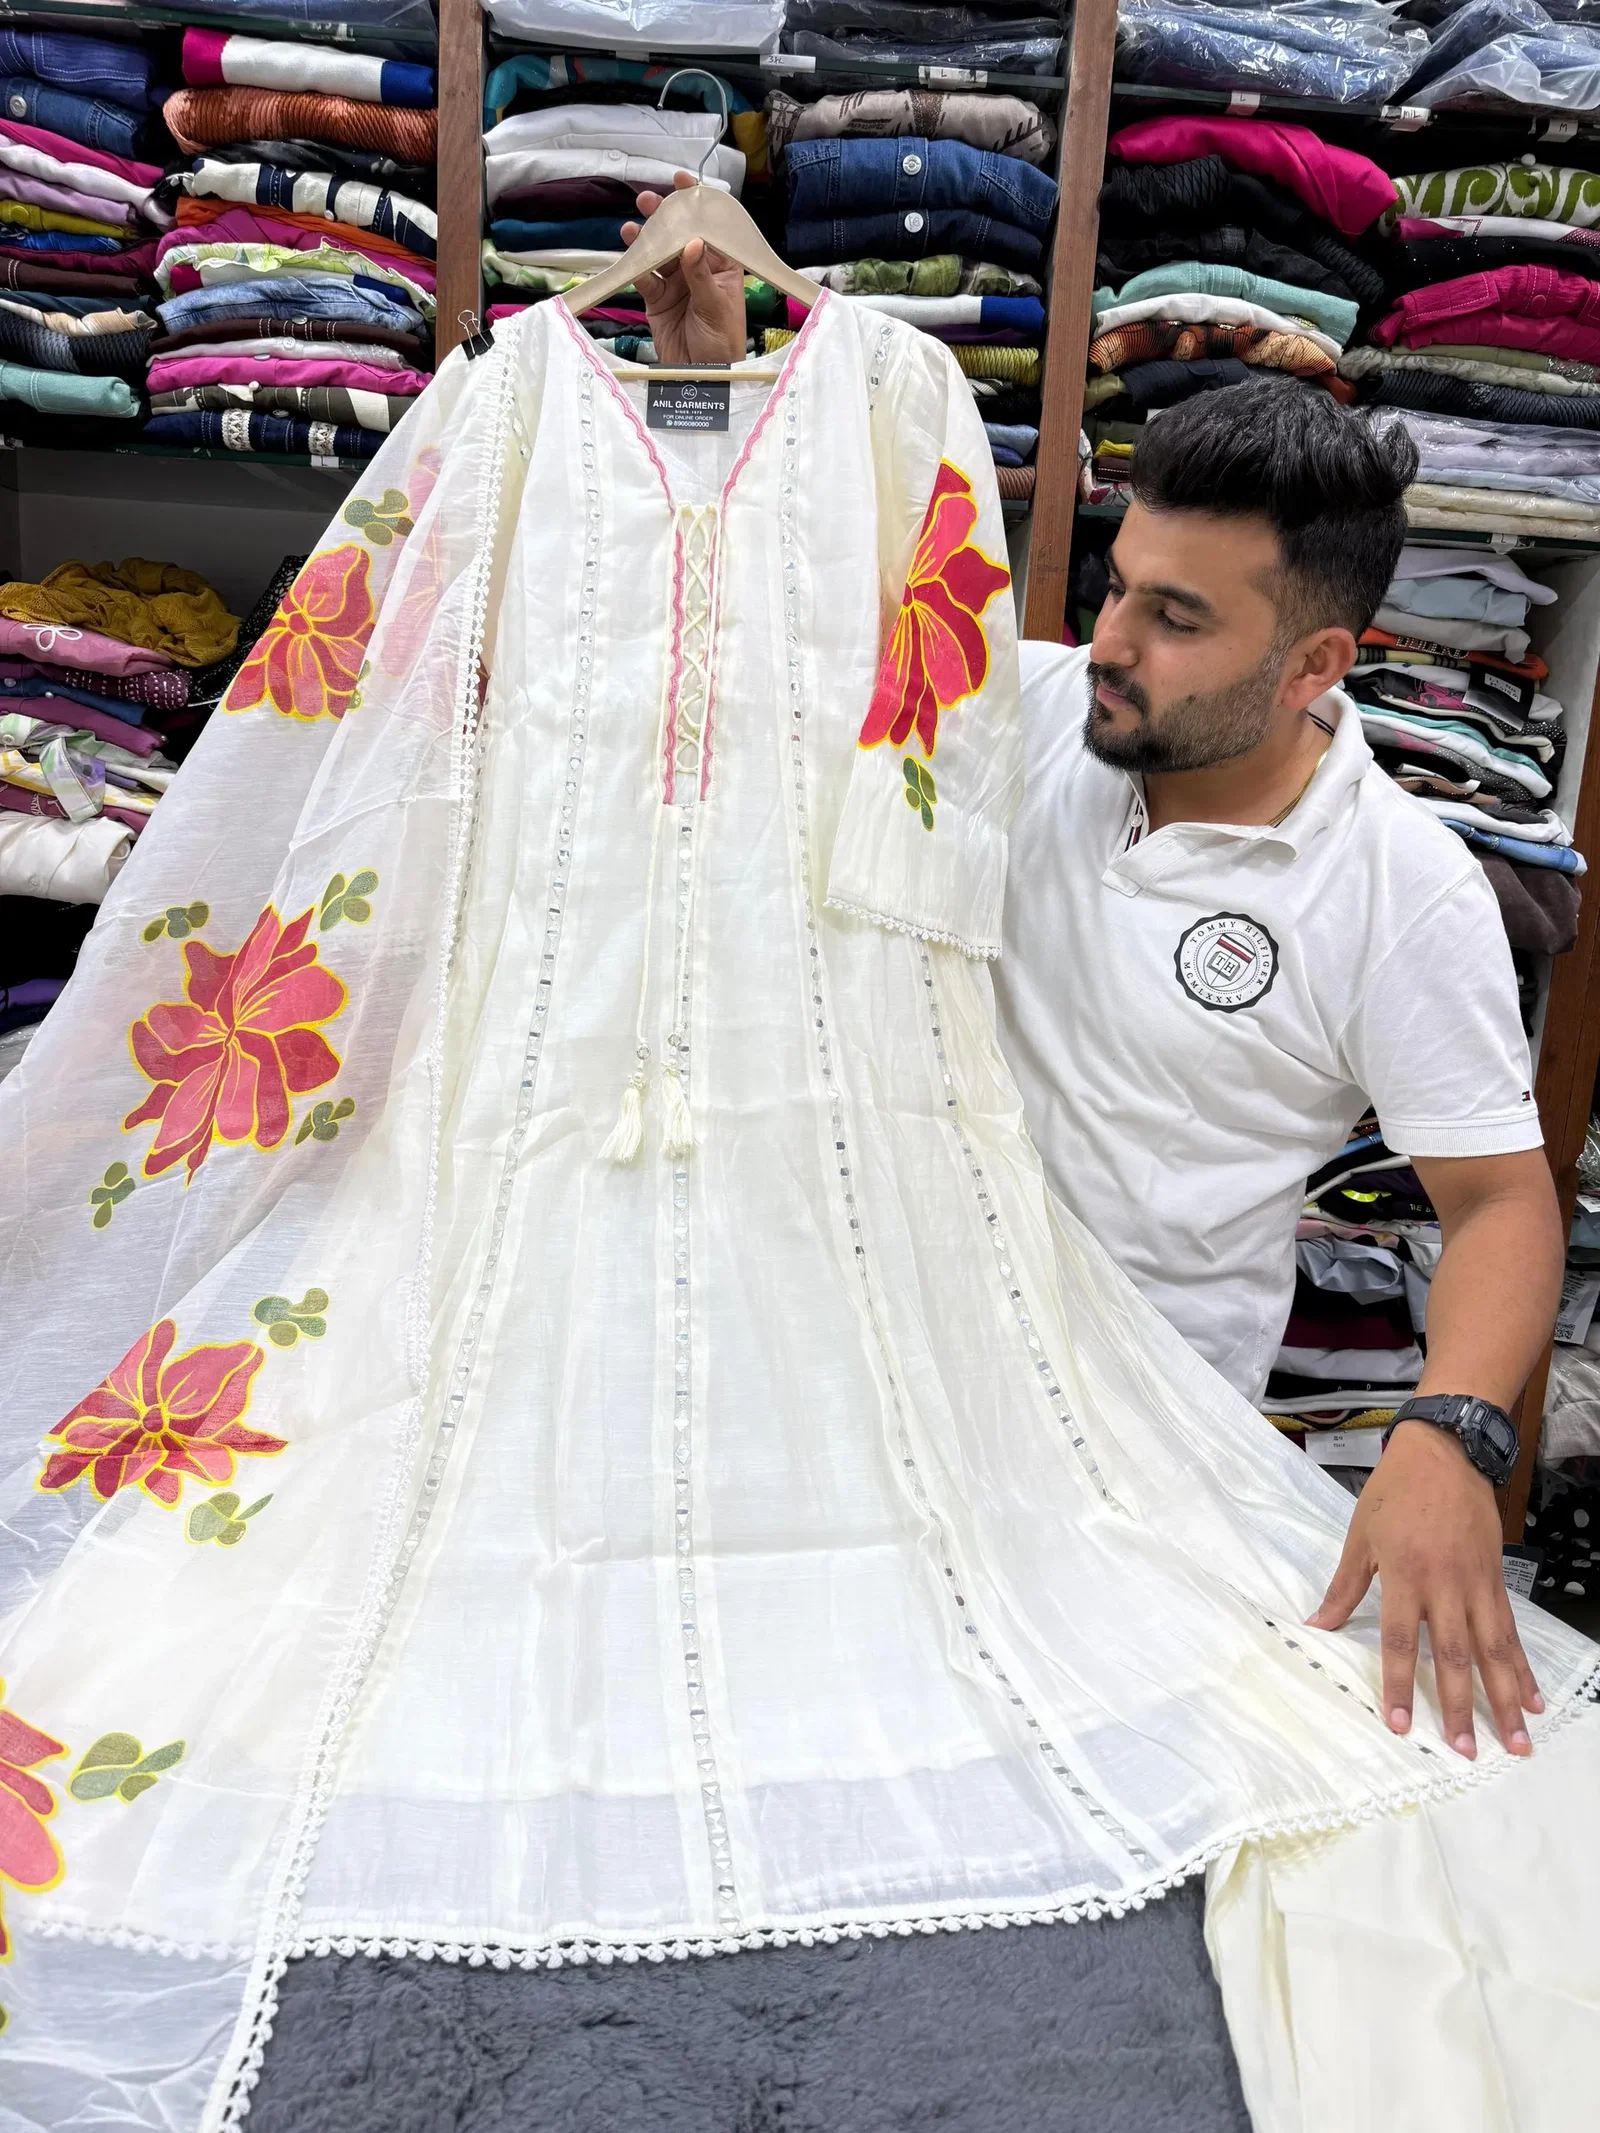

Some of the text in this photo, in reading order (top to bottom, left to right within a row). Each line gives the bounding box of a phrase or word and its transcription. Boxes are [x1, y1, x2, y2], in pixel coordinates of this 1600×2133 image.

[1559, 123, 1567, 132] M
[653, 400, 725, 410] ANIL GARMENTS
[1190, 921, 1270, 986] TOMMY HILFIGER
[1215, 955, 1236, 973] TH
[1183, 961, 1243, 1004] MCMLXXXV
